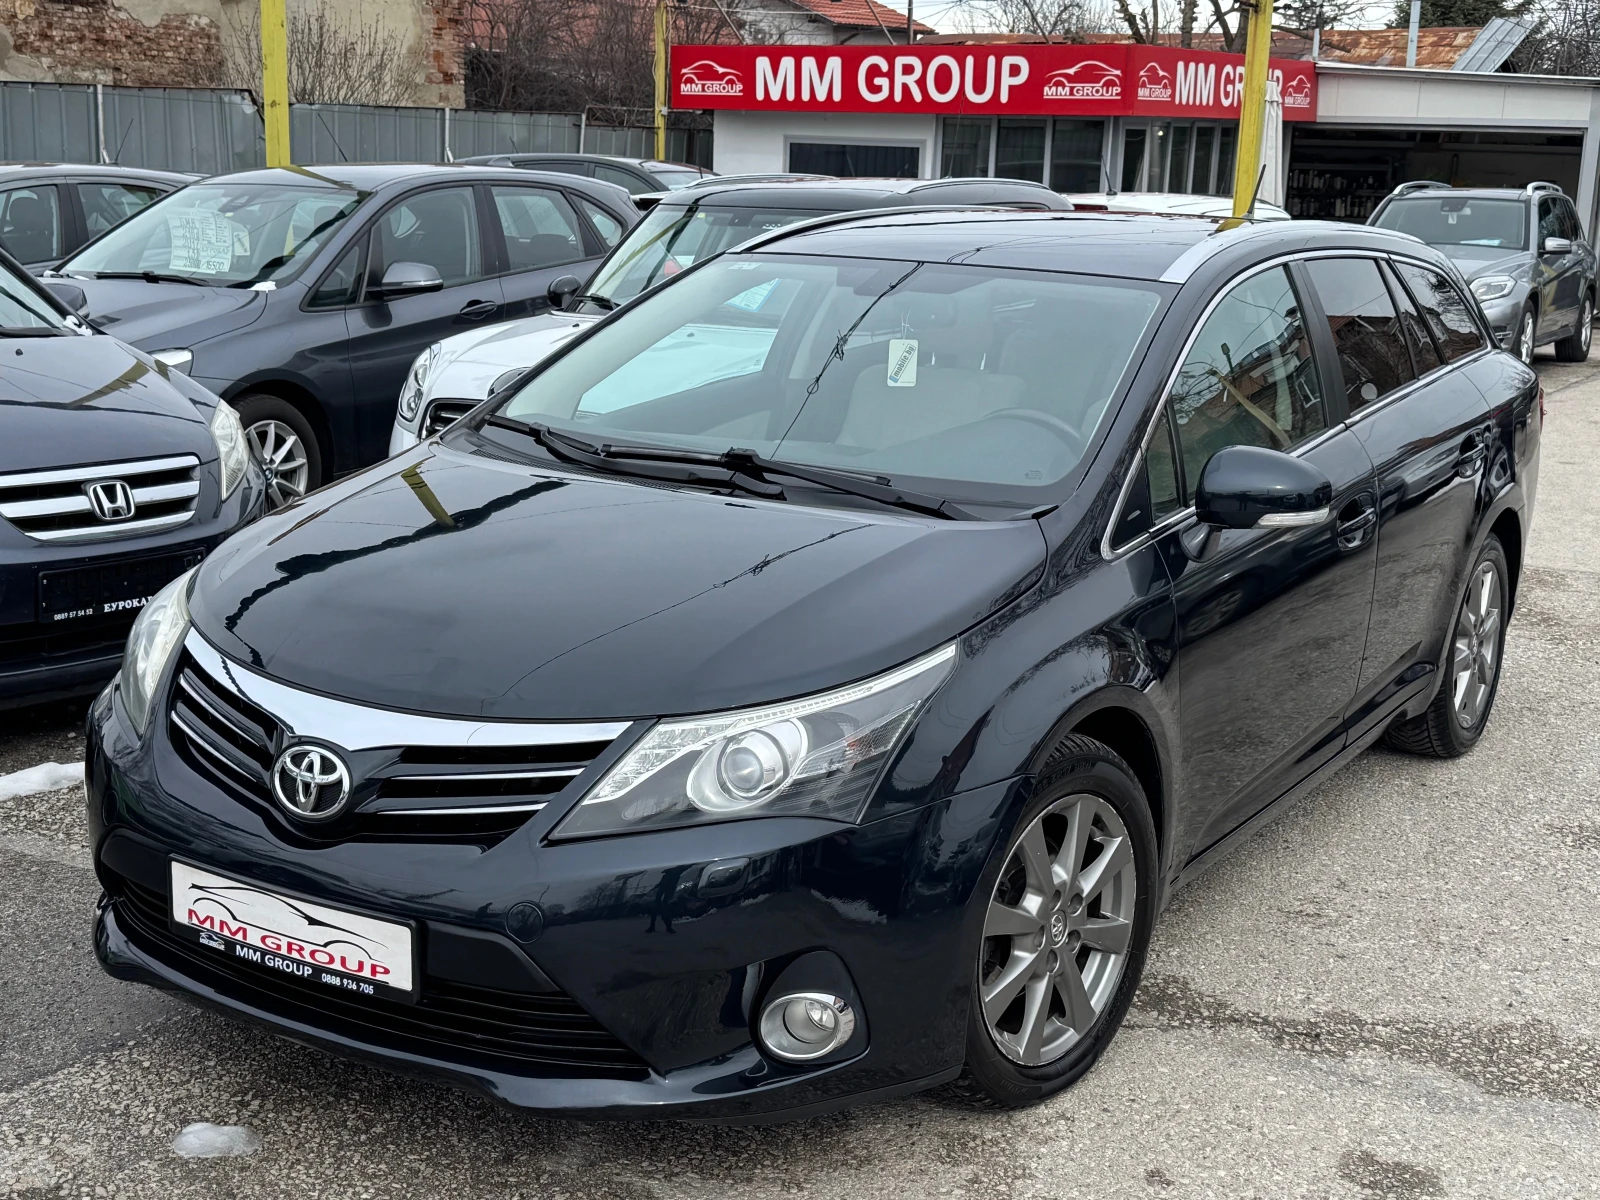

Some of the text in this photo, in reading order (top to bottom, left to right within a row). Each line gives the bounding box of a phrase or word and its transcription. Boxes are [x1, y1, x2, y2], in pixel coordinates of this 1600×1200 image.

[680, 83, 743, 93] MM GROUP
[755, 55, 1030, 104] MM GROUP
[1043, 86, 1121, 97] MM GROUP
[1137, 87, 1172, 98] MM GROUP
[1175, 60, 1284, 108] MM GRP
[1284, 95, 1310, 106] MM GROUP
[187, 908, 391, 978] MM GROUP
[235, 944, 261, 963] MM
[265, 954, 313, 977] GROUP
[321, 972, 341, 986] 0888
[342, 978, 357, 990] 936
[359, 982, 374, 995] 705
